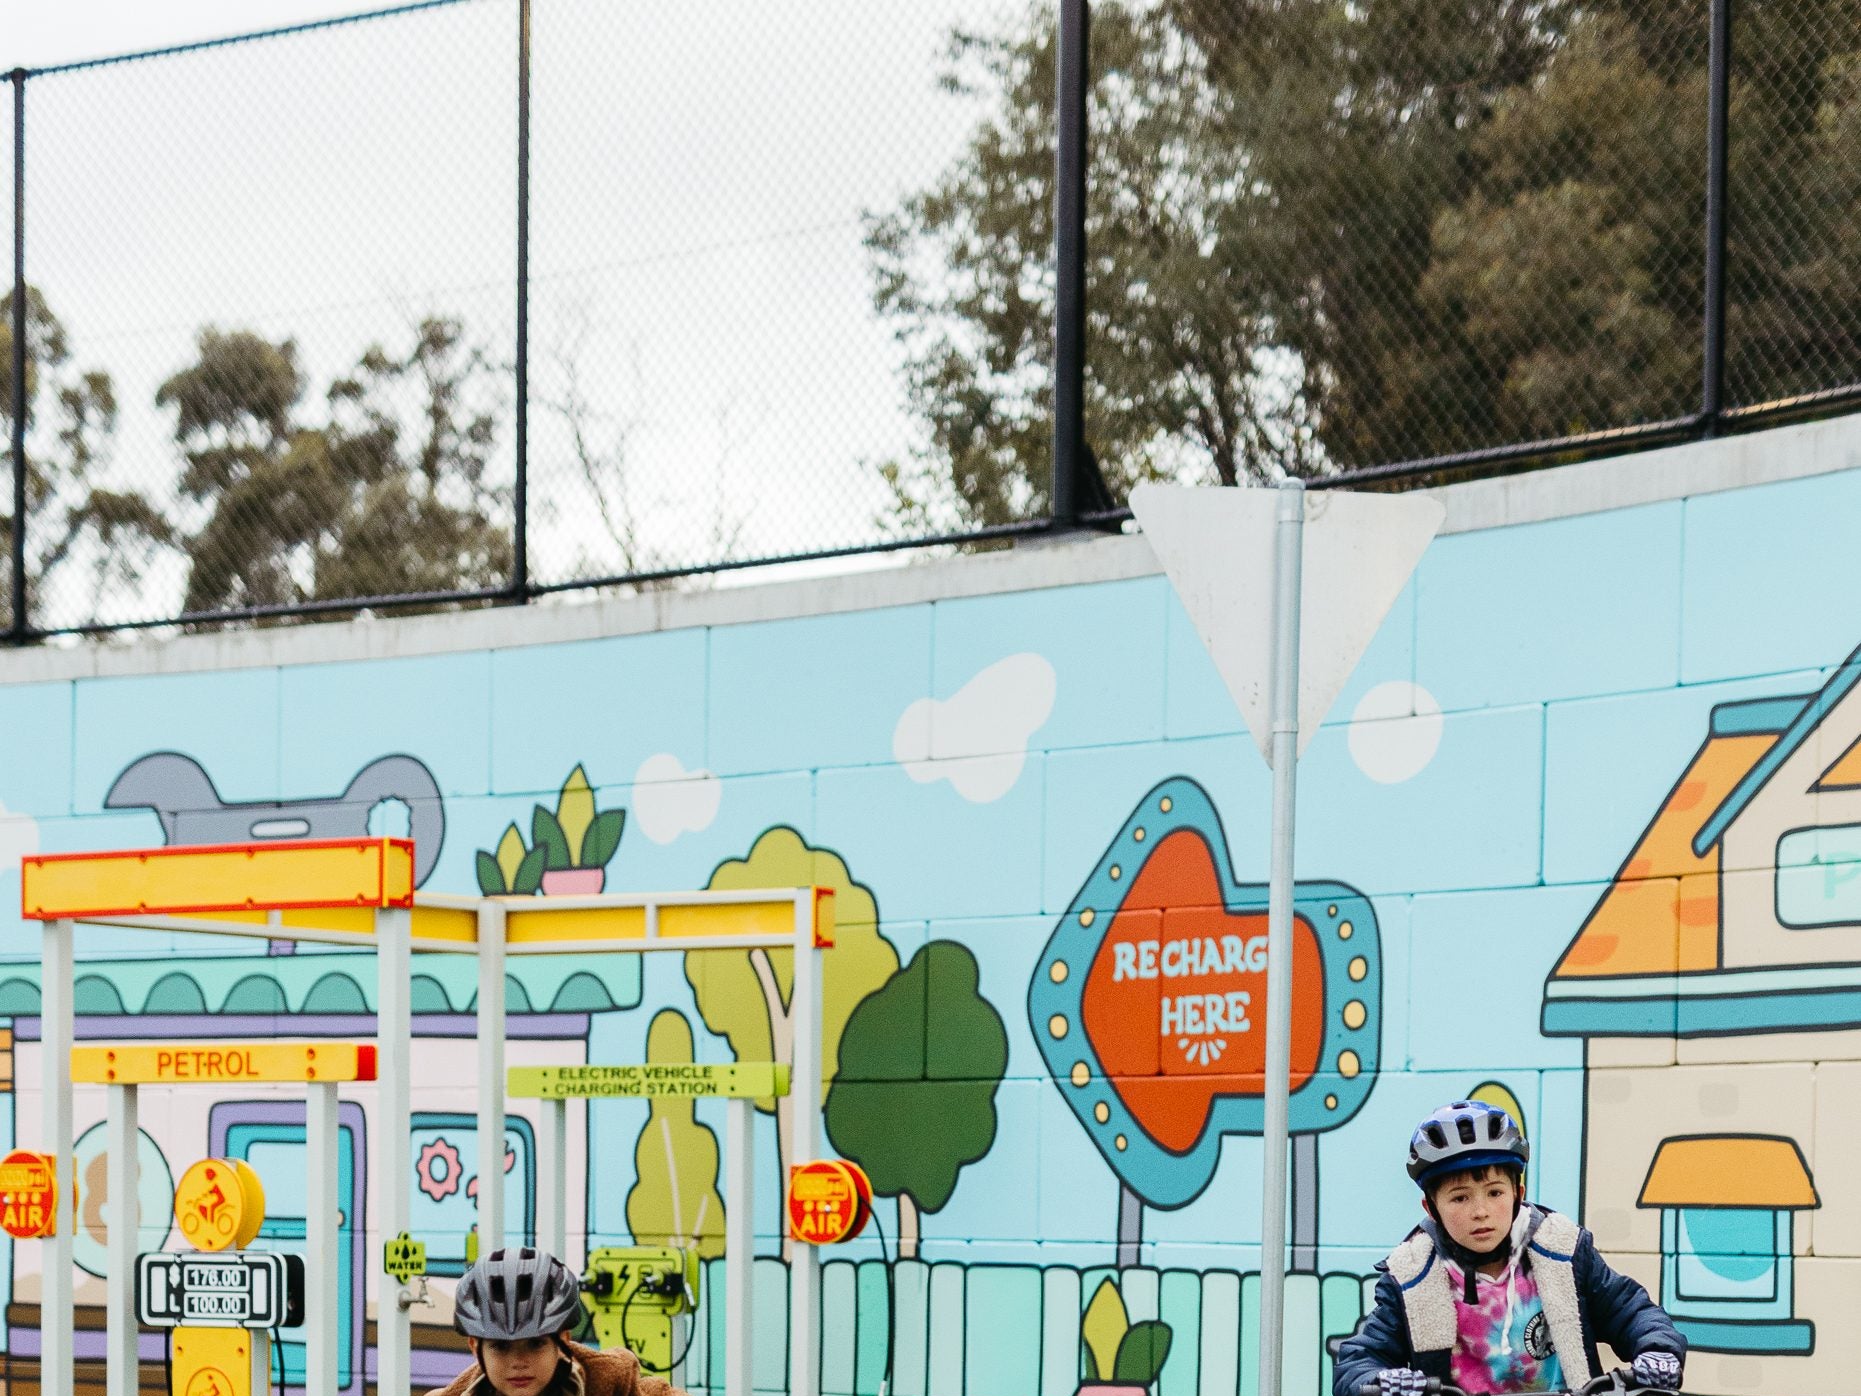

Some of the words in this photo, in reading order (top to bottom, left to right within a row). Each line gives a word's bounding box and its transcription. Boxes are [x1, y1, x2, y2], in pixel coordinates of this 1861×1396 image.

[1112, 935, 1269, 982] RECHARG
[1161, 991, 1251, 1036] HERE
[157, 1050, 259, 1077] PETROL
[558, 1067, 637, 1080] ELECTRIC
[643, 1065, 713, 1079] VEHICLE
[555, 1082, 642, 1095] CHARGING
[646, 1081, 717, 1095] STATION
[2, 1205, 43, 1229] AIR
[800, 1213, 843, 1235] AIR
[169, 1292, 181, 1313] L
[190, 1296, 242, 1314] 100.00
